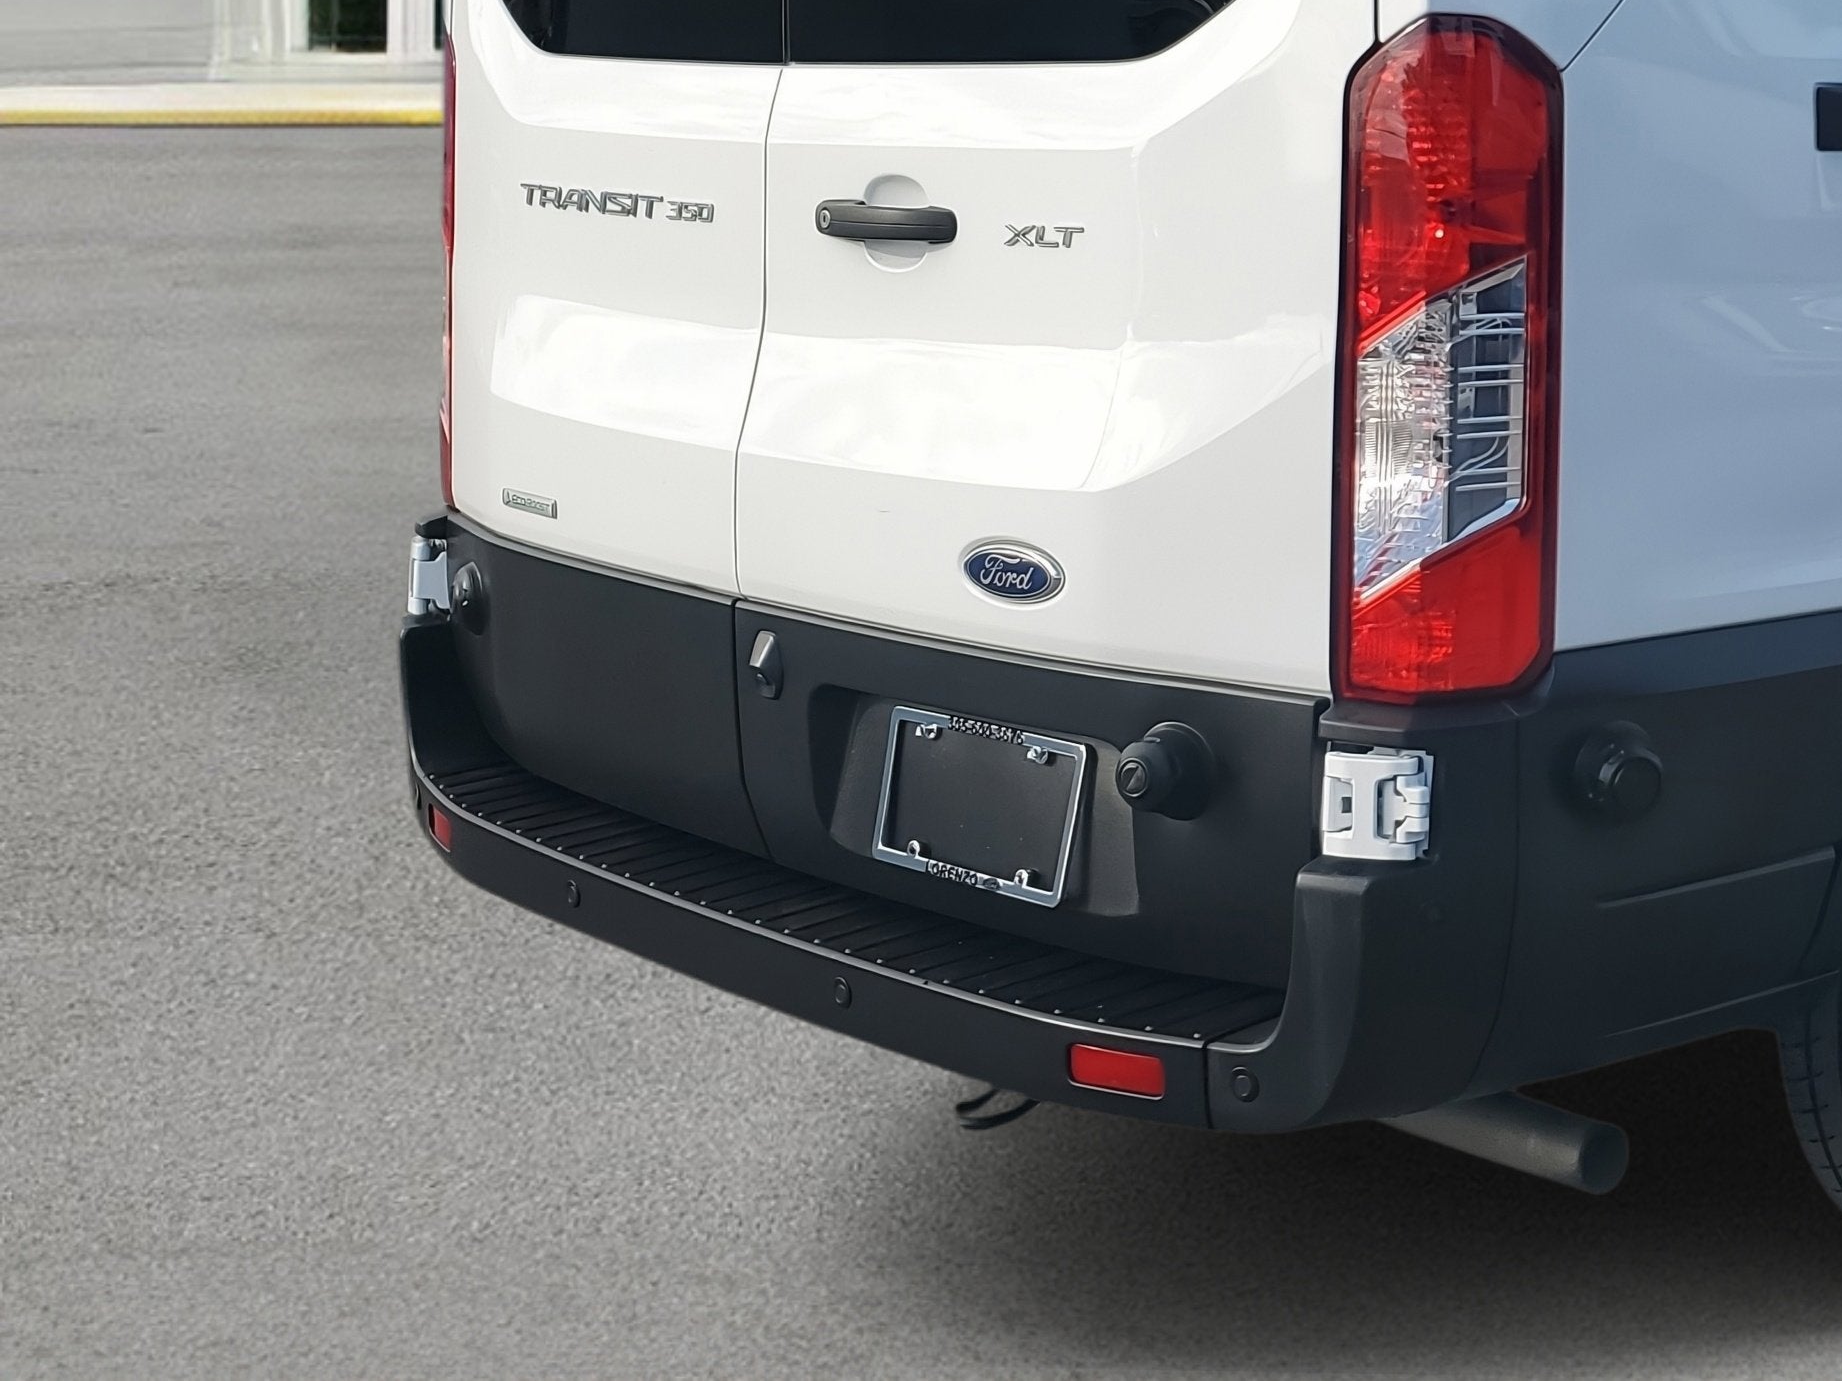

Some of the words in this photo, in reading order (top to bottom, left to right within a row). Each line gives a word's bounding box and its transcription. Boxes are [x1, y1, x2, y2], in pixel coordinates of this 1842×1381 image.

[520, 182, 664, 220] TRANSIT
[666, 200, 714, 223] 350
[1004, 224, 1085, 249] XLT
[980, 554, 1034, 590] Ford
[926, 859, 978, 886] LORENZO
